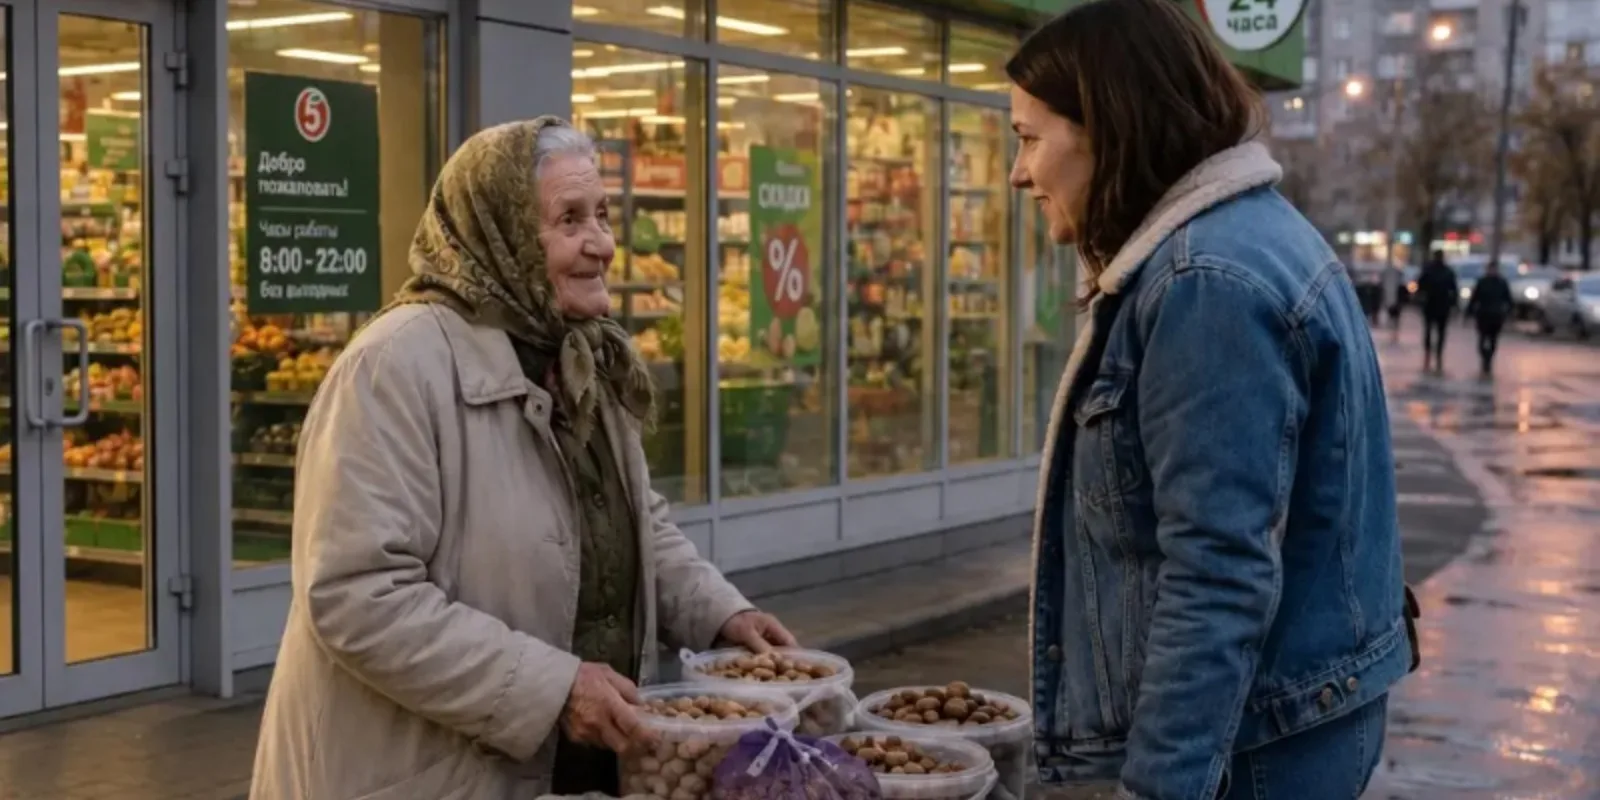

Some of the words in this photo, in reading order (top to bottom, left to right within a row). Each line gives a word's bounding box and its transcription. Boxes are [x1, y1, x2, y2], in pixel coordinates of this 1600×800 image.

[1226, 14, 1278, 33] часа
[257, 151, 306, 177] Добро
[258, 177, 348, 197] пожаловать!
